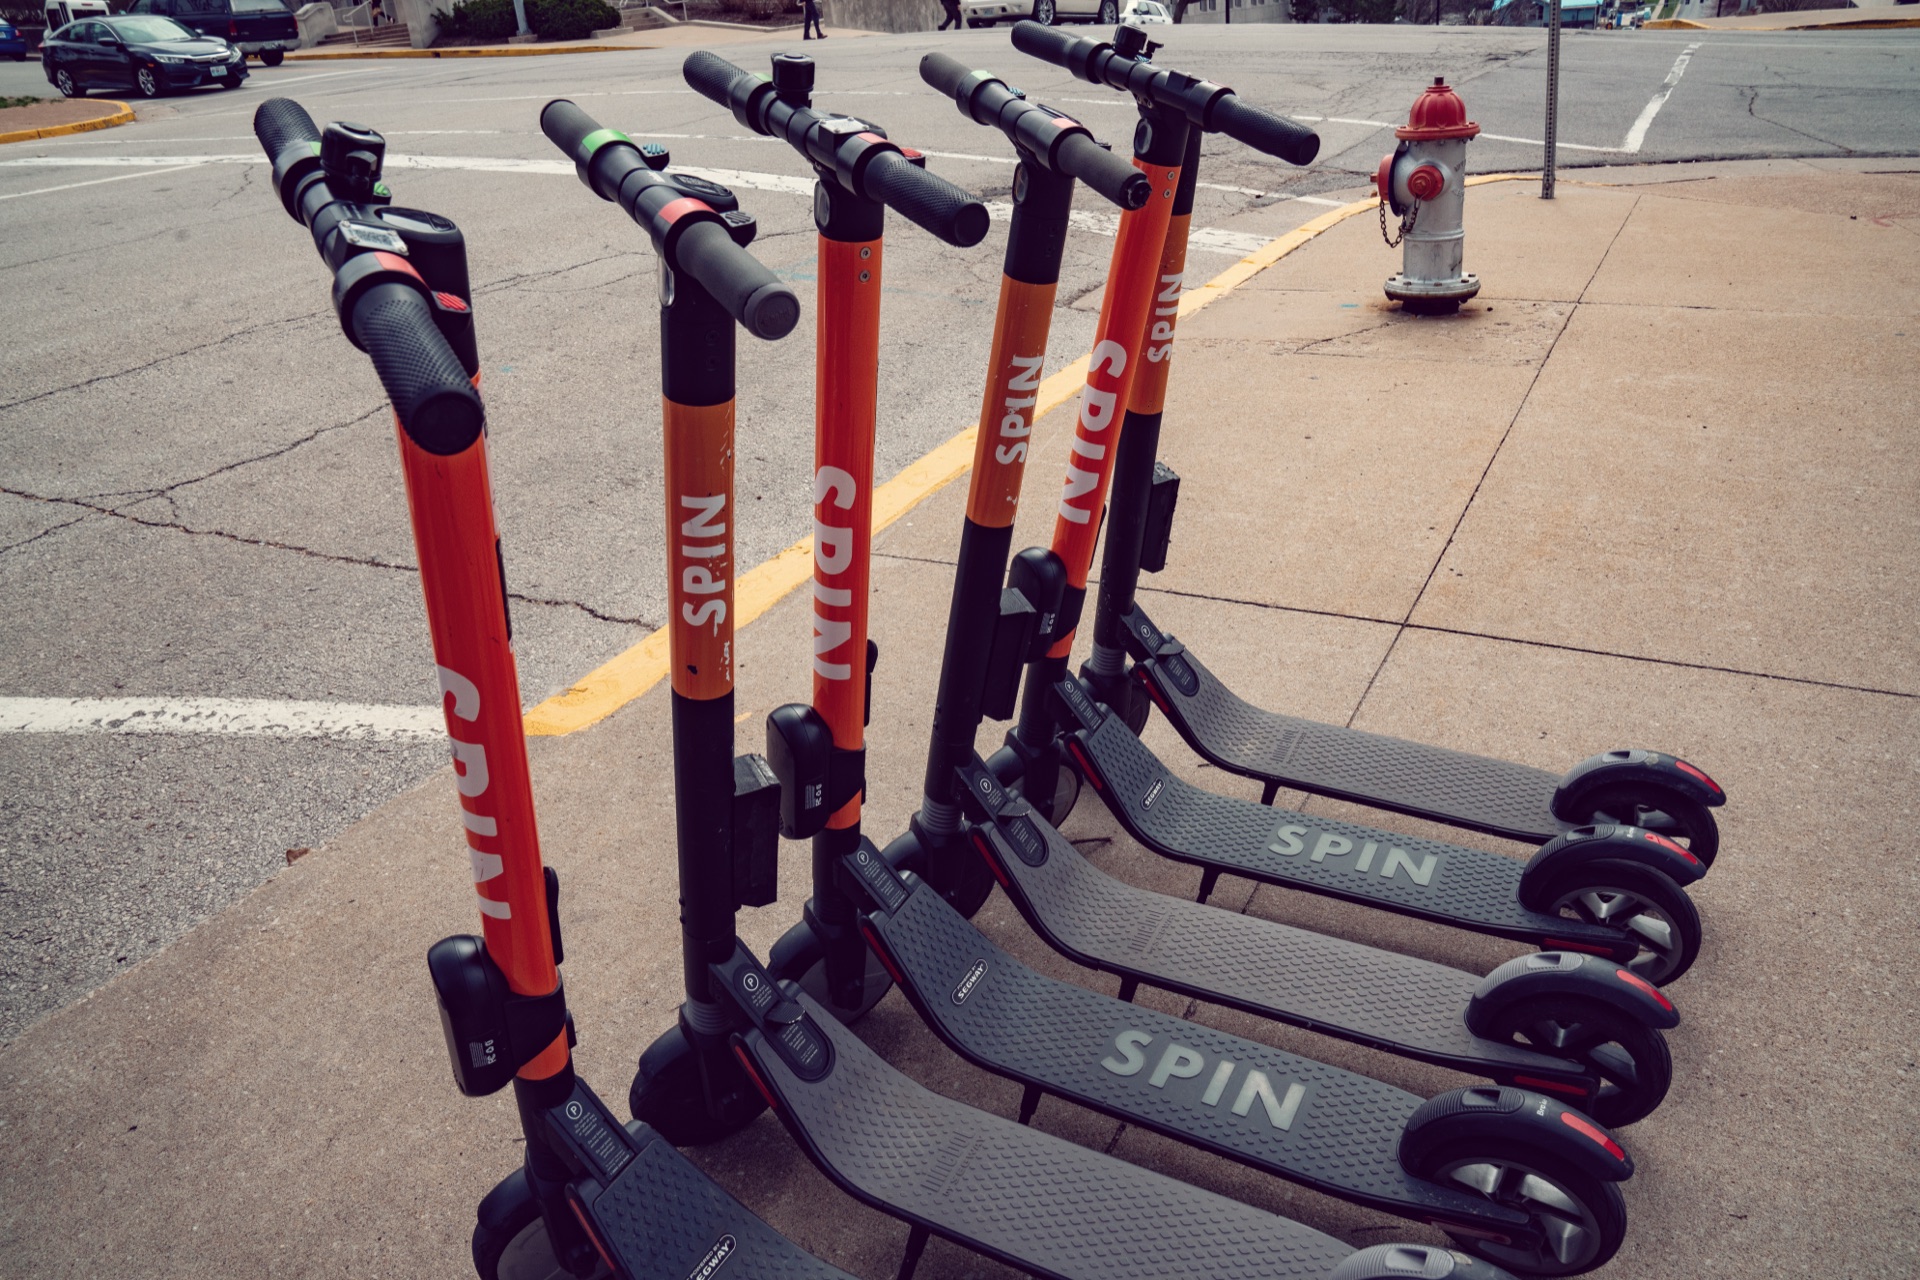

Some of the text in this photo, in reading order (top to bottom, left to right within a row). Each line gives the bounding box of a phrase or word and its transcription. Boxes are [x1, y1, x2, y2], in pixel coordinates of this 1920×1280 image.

[1147, 272, 1183, 363] SPIN
[996, 355, 1044, 465] SPIN
[1058, 340, 1127, 525] SPIN
[681, 493, 727, 630] SPIN
[814, 466, 857, 680] SPIN
[1268, 825, 1438, 887] SPIN
[957, 963, 984, 999] SEGWAY
[1101, 1030, 1306, 1132] SPIN
[690, 1250, 714, 1279] POWERED
[696, 1240, 730, 1280] EGWAY
